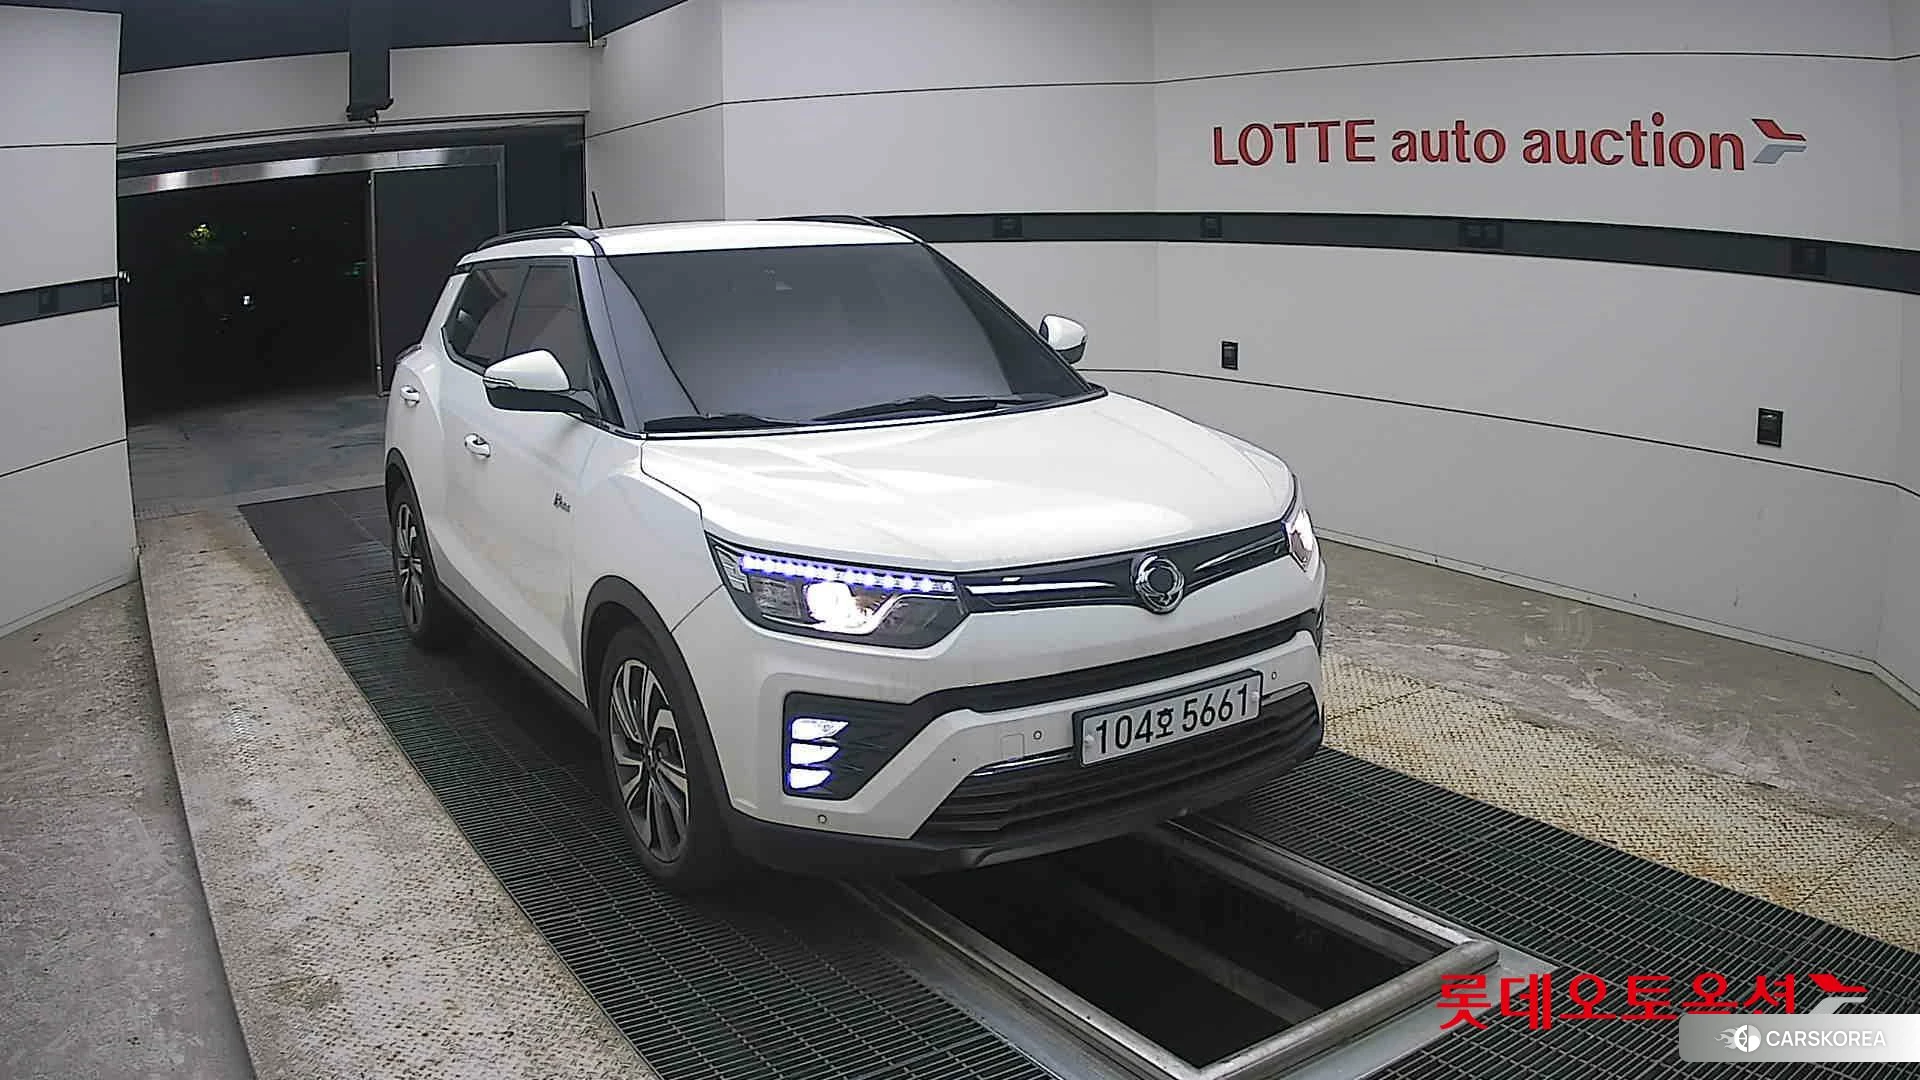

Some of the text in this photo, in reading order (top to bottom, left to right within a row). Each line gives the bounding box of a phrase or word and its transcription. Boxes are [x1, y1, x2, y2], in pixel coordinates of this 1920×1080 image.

[1213, 112, 1745, 171] LOTTE auto auction
[1182, 683, 1248, 733] 5661
